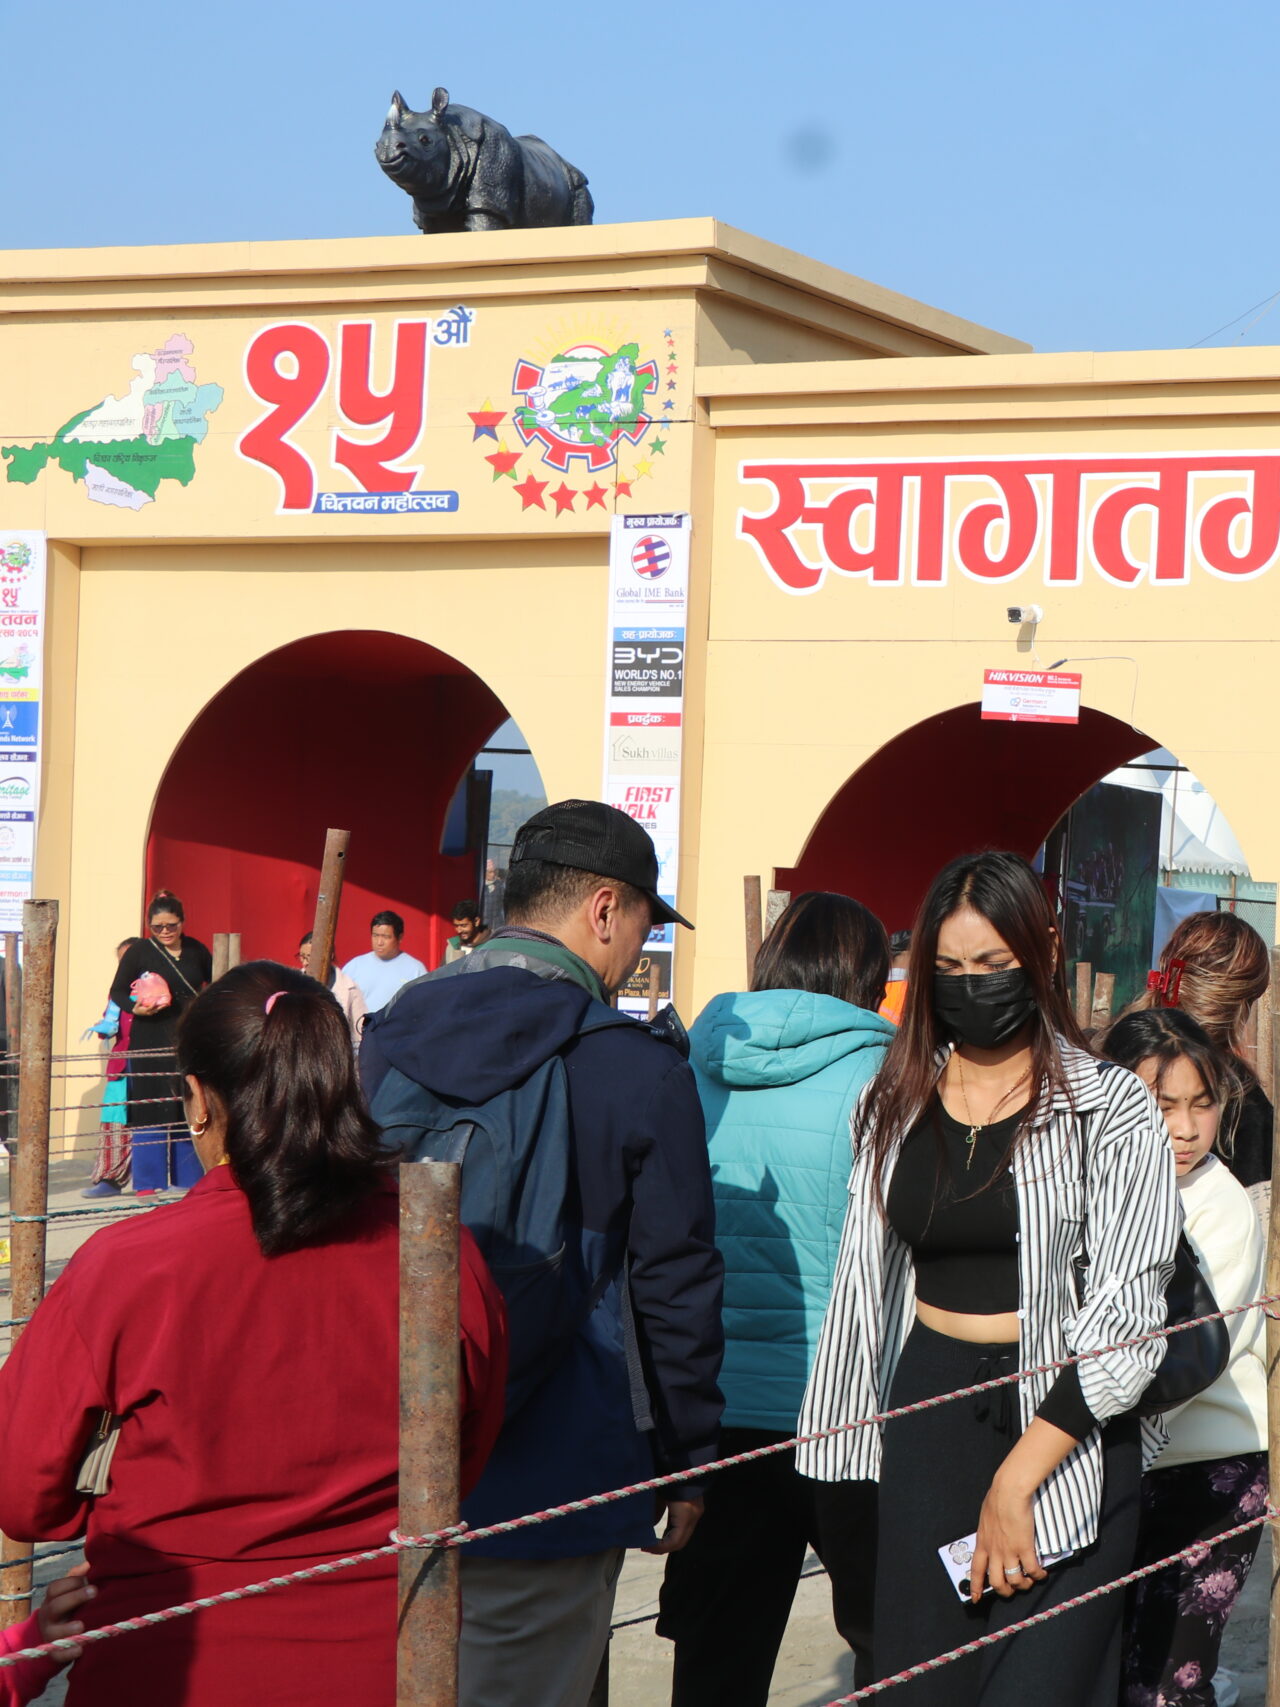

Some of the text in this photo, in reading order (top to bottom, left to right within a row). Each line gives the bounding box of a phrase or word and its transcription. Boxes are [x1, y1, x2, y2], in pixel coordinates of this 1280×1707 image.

[240, 322, 427, 510] १५
[320, 492, 451, 511] चितवन महोत्सव
[626, 517, 644, 529] मुख्य
[616, 588, 684, 598] Global IME Bank
[614, 647, 682, 663] BYD
[614, 669, 682, 680] WORLD'S NO.1
[989, 671, 1045, 683] HIKVISION
[622, 746, 679, 759] Sukh villas
[625, 787, 674, 802] FIRST
